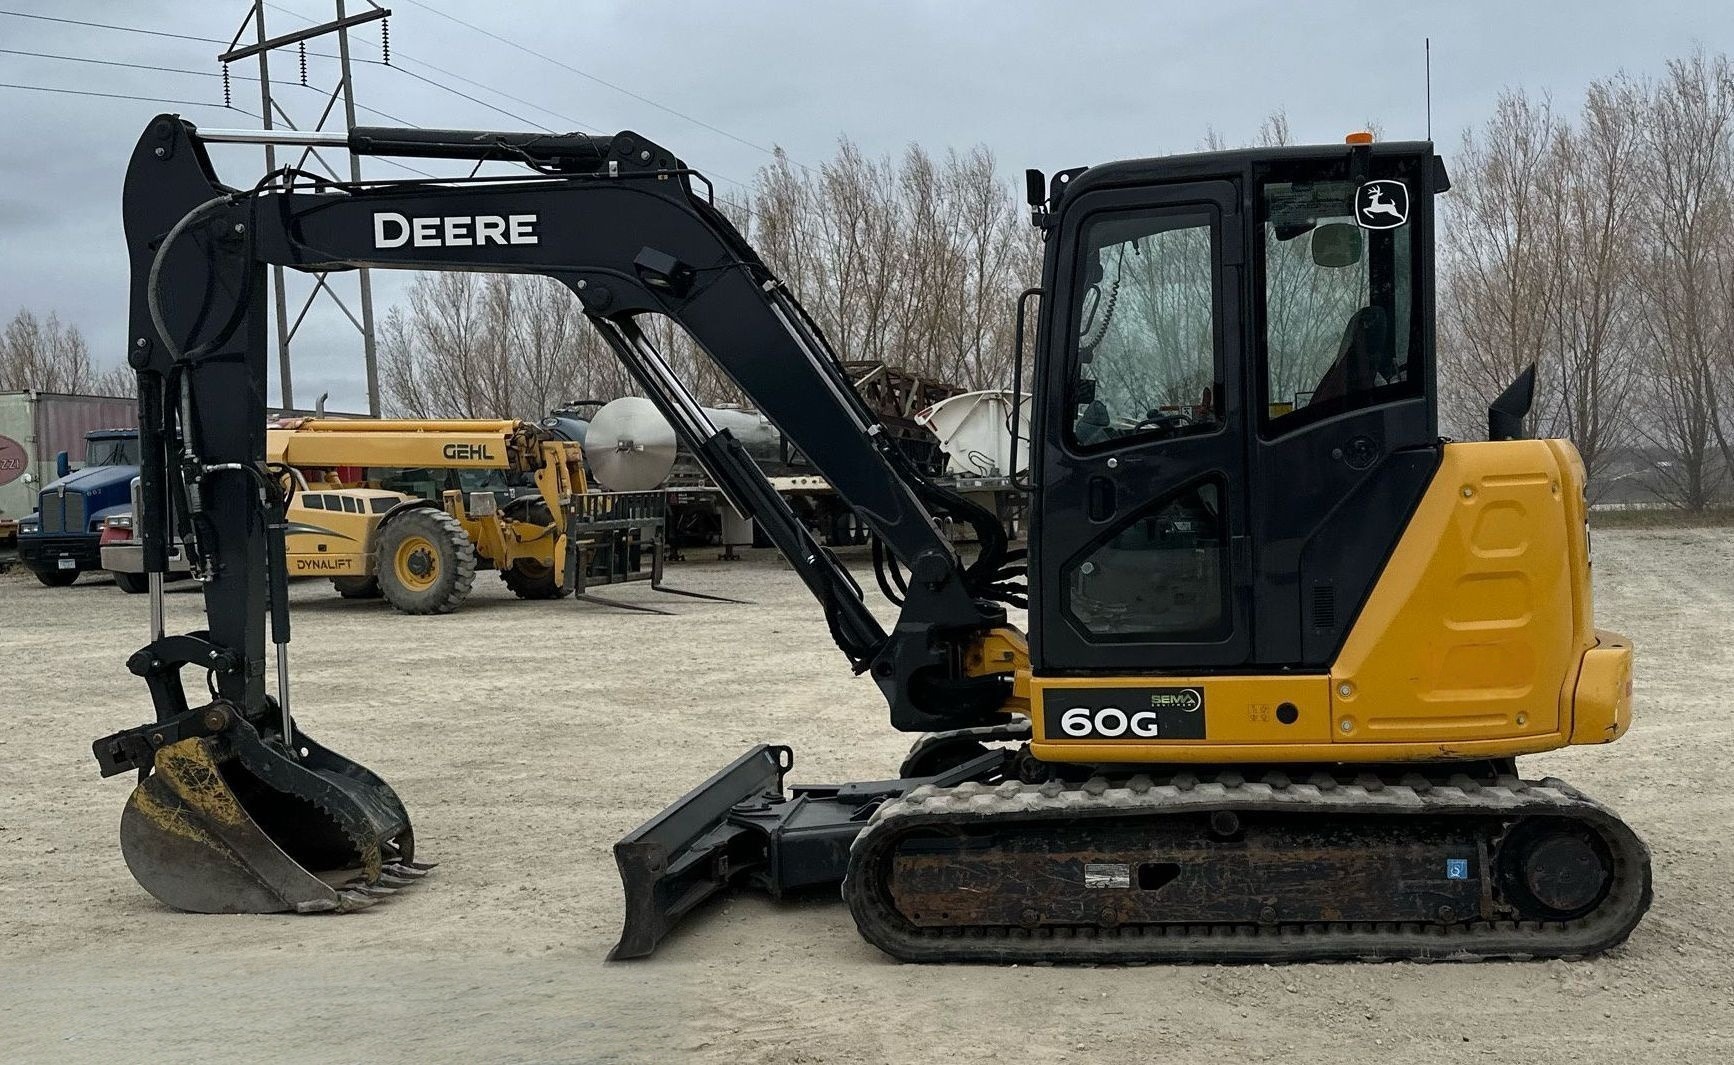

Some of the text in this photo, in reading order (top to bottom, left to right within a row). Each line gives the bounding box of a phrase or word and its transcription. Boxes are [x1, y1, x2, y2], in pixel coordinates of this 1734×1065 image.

[373, 212, 538, 249] DEERE
[443, 444, 495, 460] GEHL
[297, 559, 352, 570] DYNALIFT
[1151, 694, 1196, 704] SEMA
[1061, 707, 1158, 737] 60G
